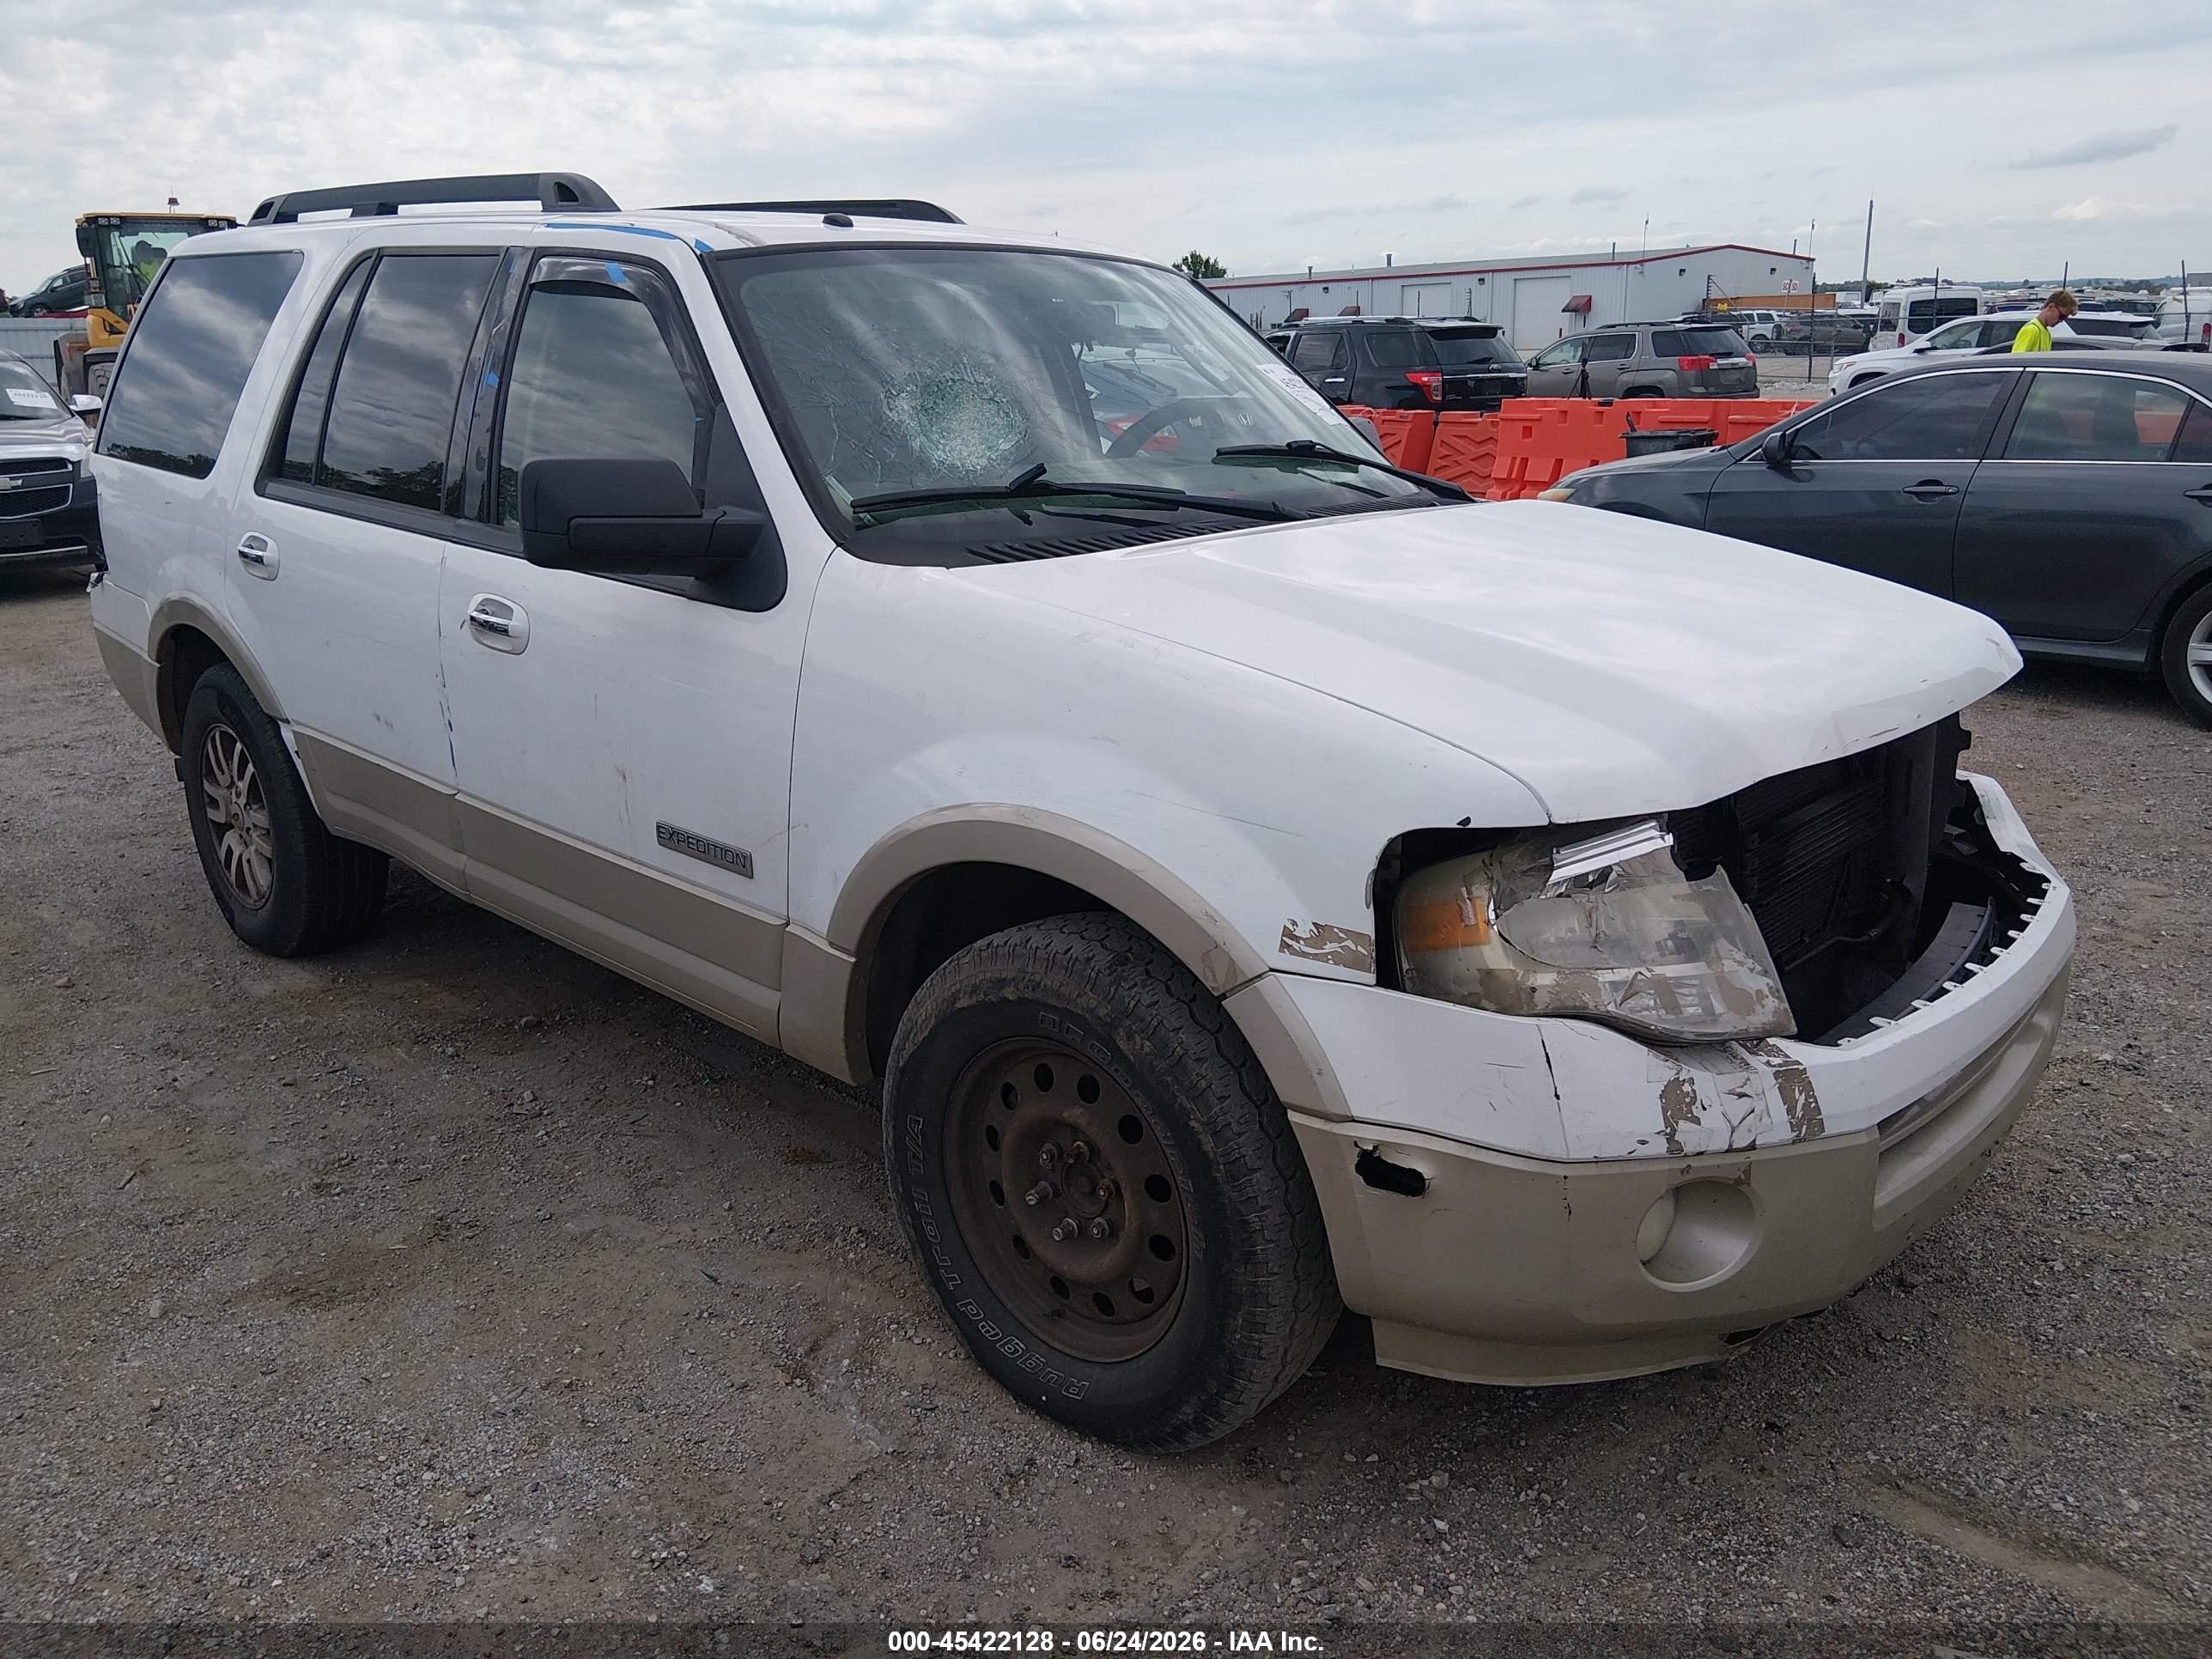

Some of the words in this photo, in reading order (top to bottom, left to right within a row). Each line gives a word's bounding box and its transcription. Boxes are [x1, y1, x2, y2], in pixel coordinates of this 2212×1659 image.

[657, 824, 747, 869] EXPEDITION
[906, 1114, 926, 1176] T/A
[911, 1184, 963, 1291] Trail
[956, 1297, 1091, 1401] Rugged
